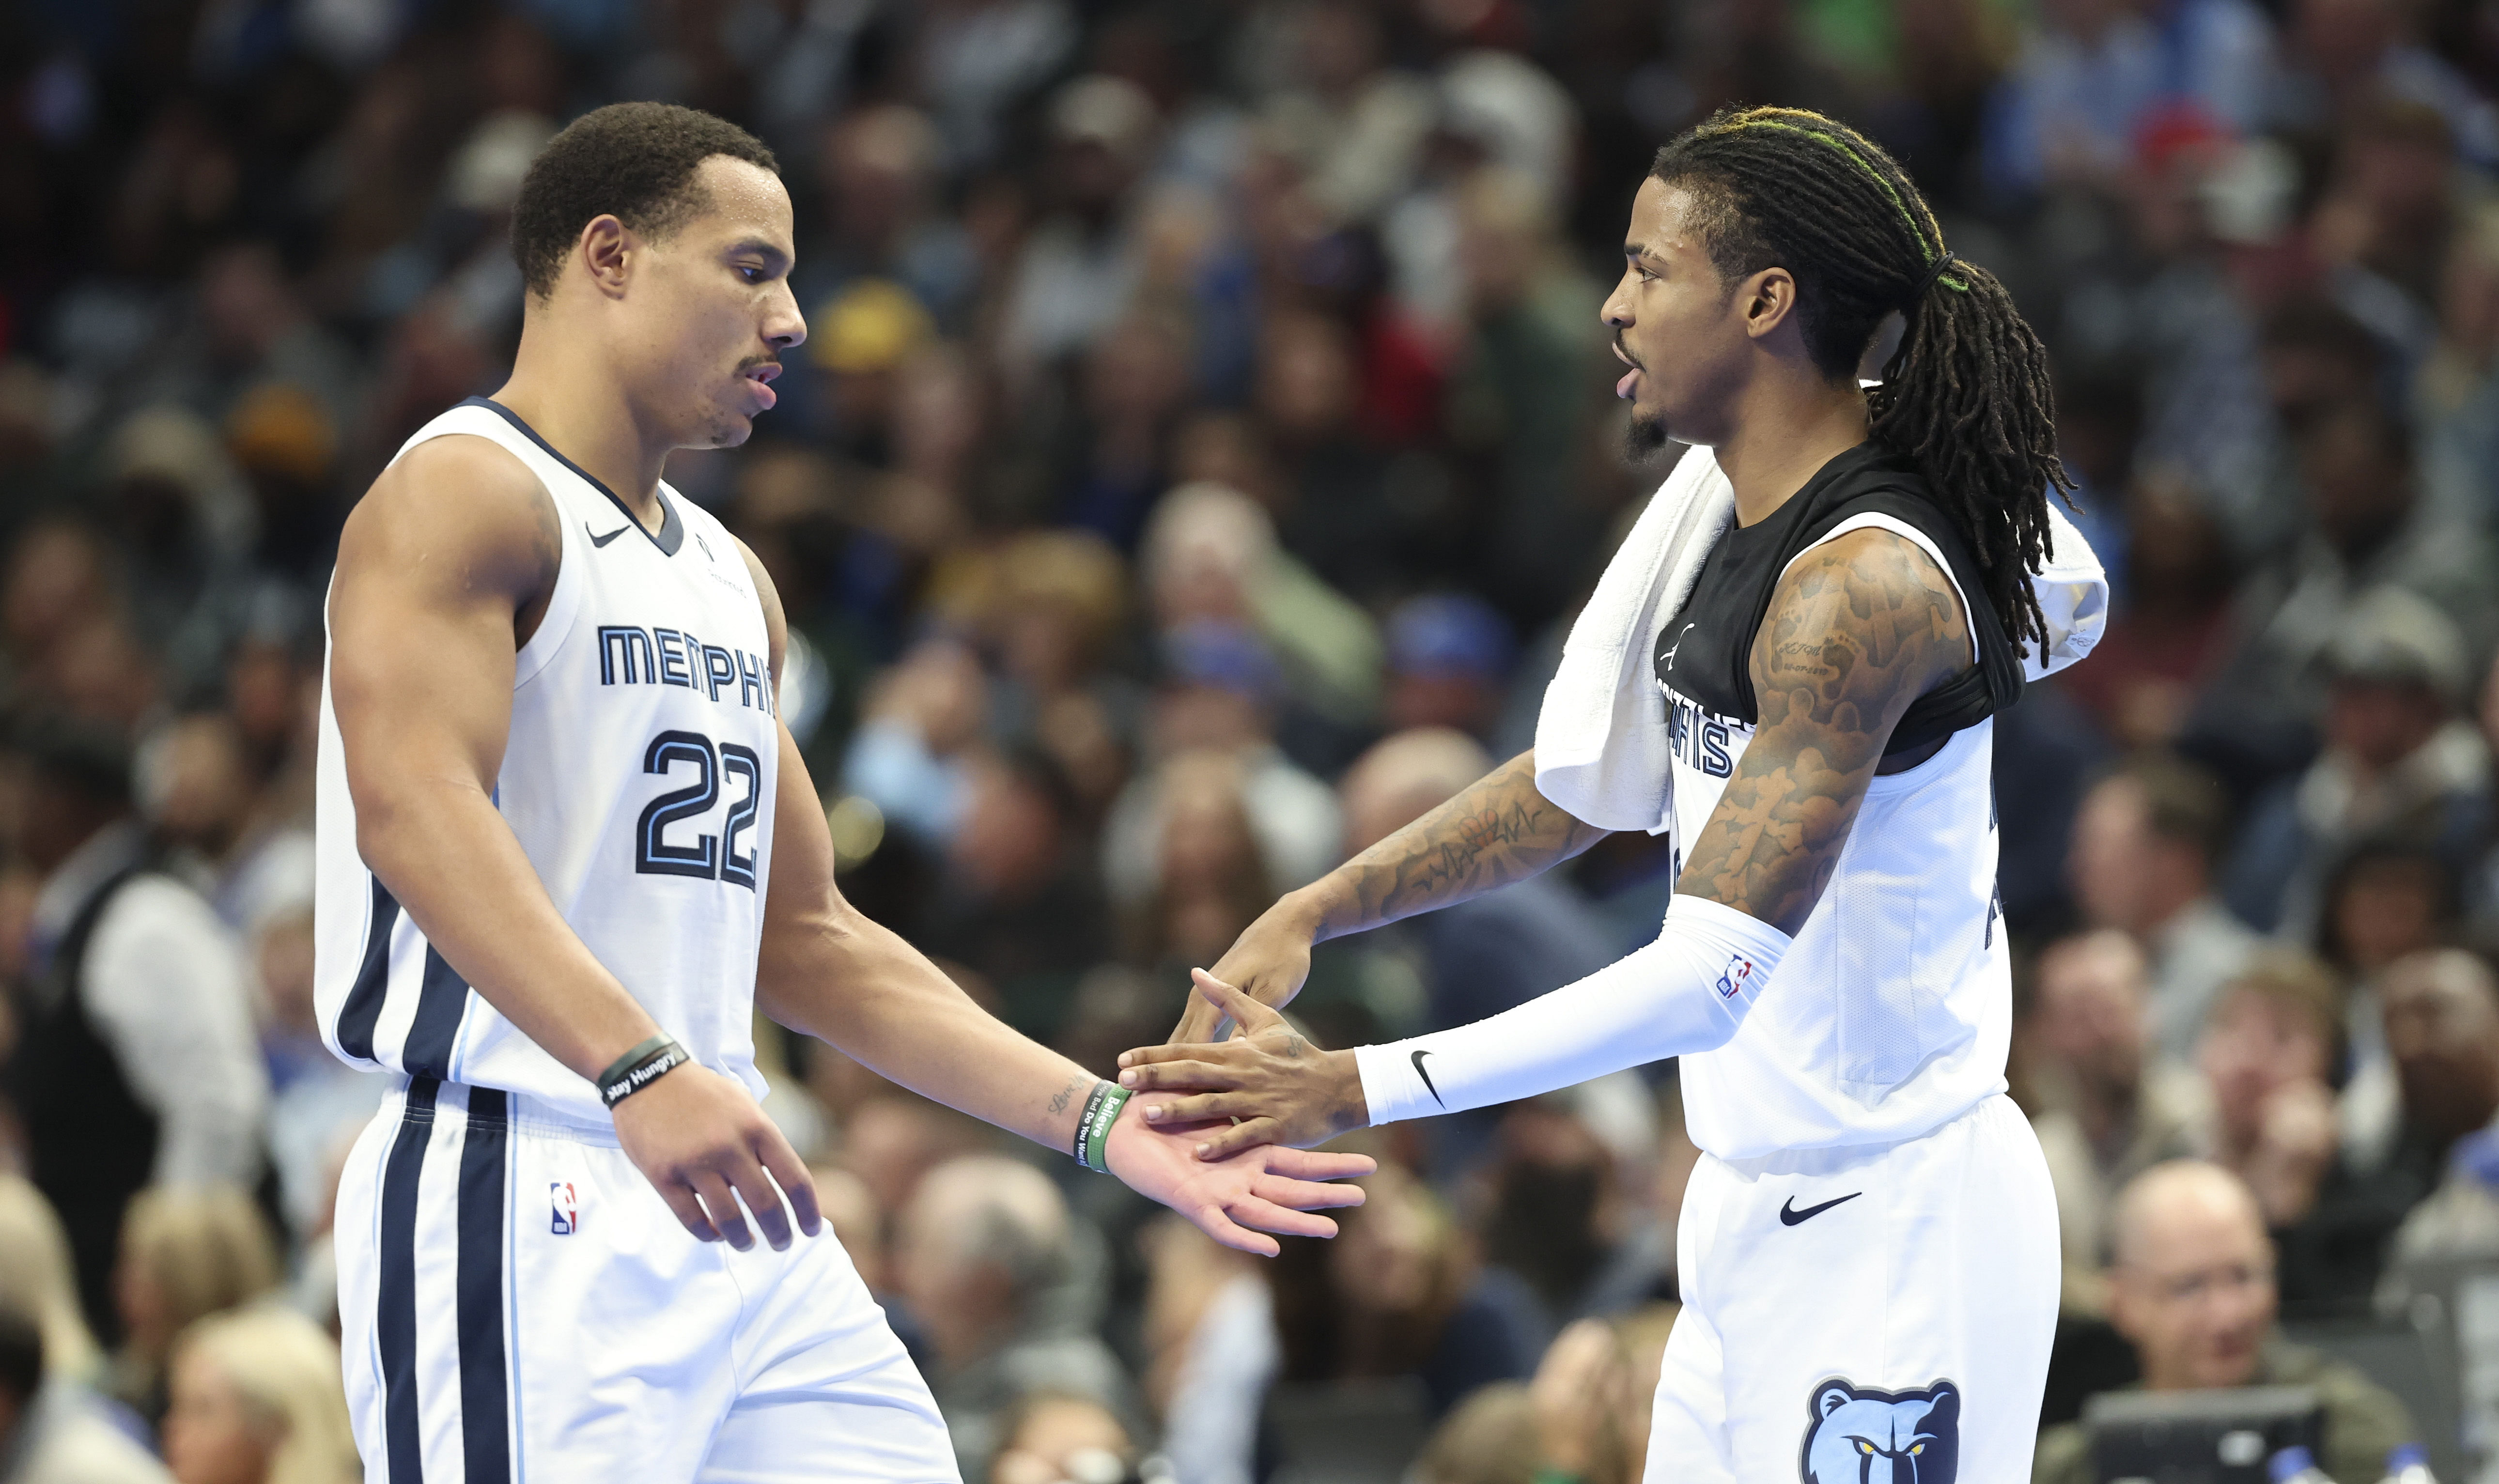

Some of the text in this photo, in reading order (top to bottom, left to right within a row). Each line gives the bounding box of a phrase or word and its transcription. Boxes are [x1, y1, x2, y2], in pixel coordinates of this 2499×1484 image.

[598, 626, 776, 720] MEMPHI
[636, 729, 761, 894] 22
[1084, 1111, 1095, 1124] Do
[1089, 1097, 1102, 1111] Bad
[1092, 1096, 1121, 1138] Believe
[1079, 1126, 1090, 1141] You
